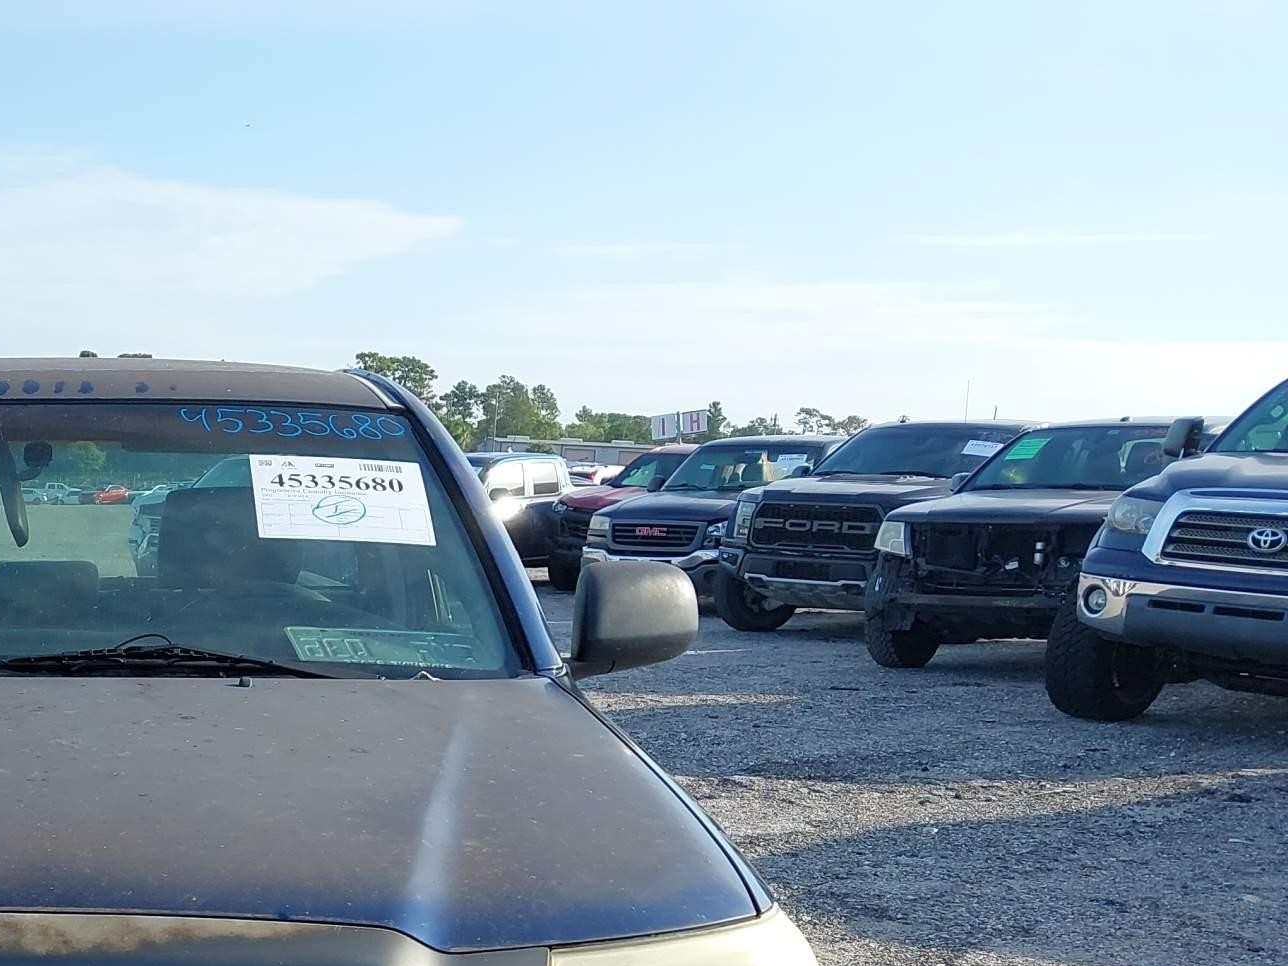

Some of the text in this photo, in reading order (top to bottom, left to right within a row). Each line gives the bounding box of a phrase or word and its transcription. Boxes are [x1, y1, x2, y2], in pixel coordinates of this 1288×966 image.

[180, 408, 405, 440] 45335680
[689, 412, 701, 431] H
[270, 473, 404, 493] 45335680
[635, 526, 668, 537] GMC
[754, 517, 873, 535] FORD
